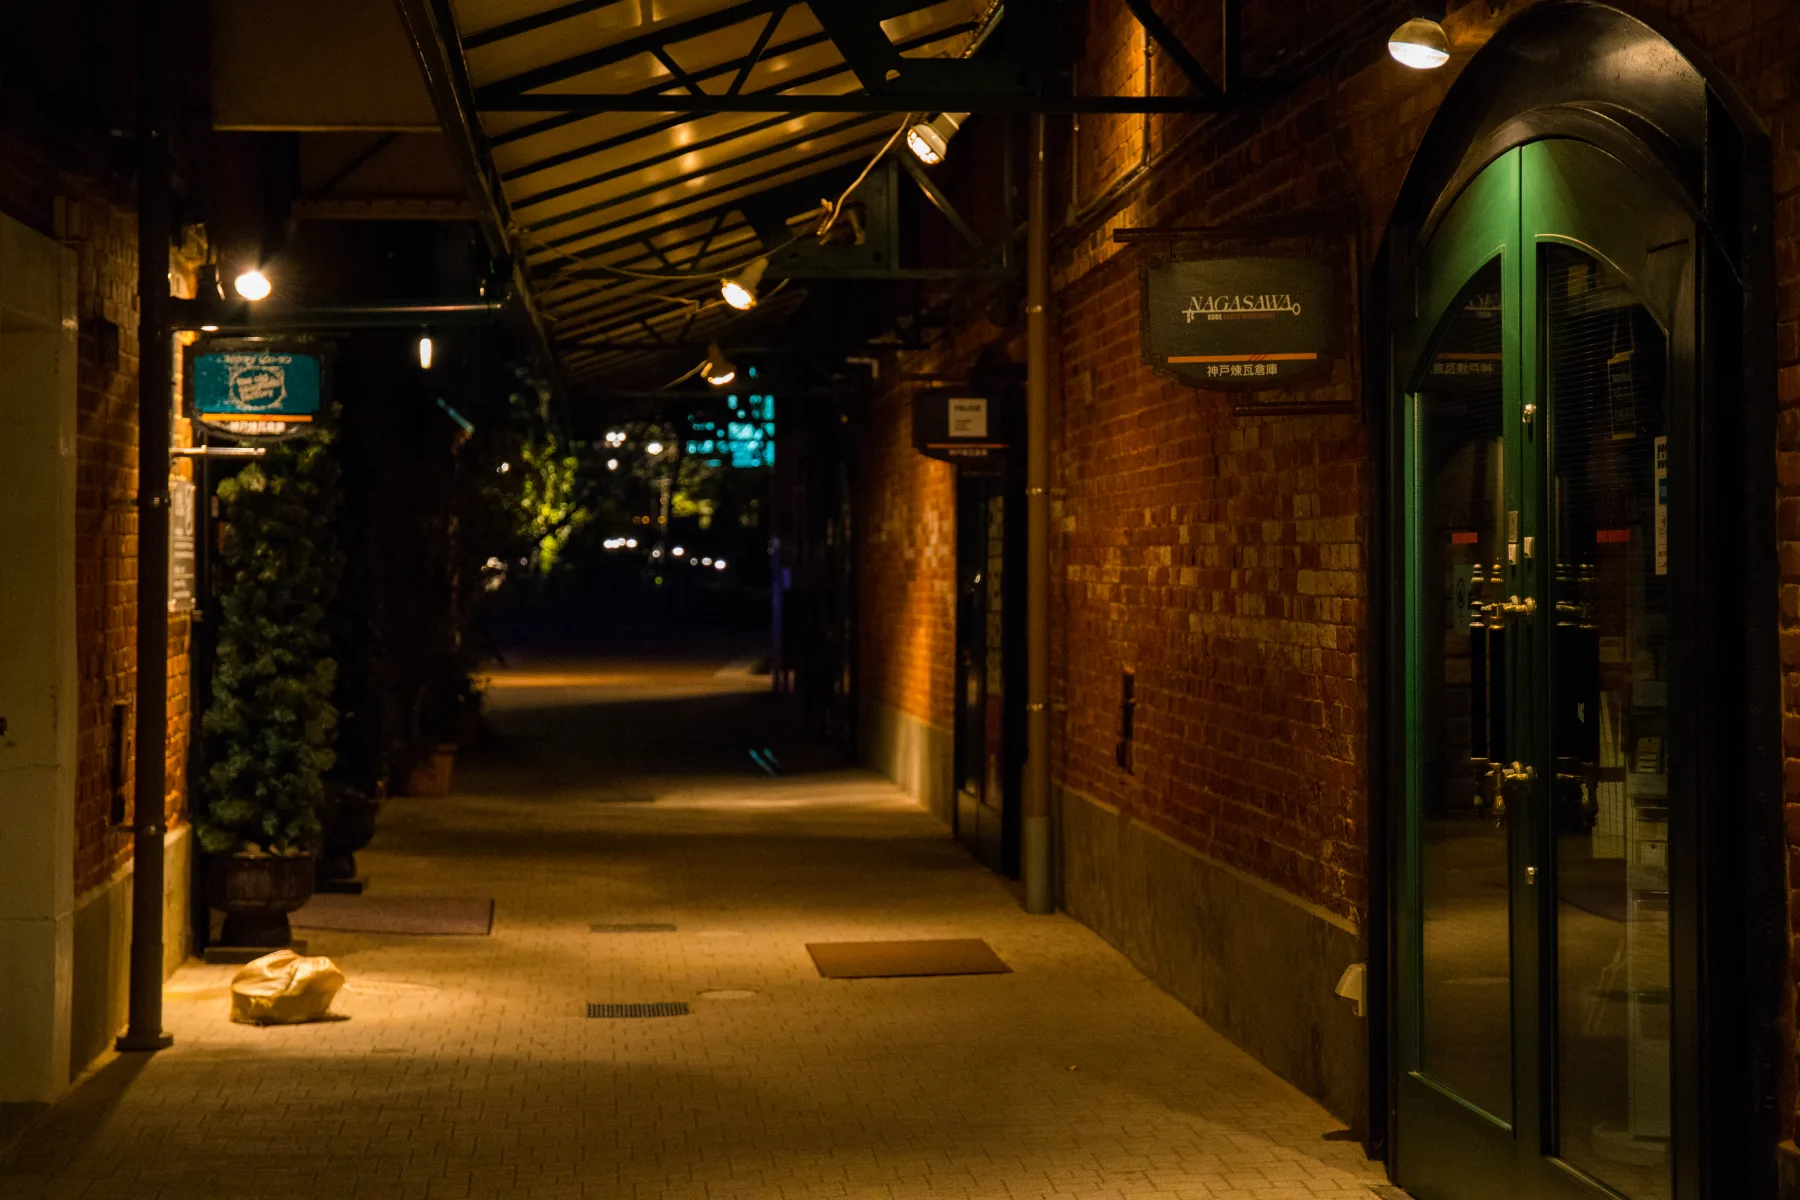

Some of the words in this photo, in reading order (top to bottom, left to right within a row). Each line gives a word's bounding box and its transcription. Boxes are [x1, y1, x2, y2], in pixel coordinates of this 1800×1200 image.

[1188, 294, 1292, 311] NAGASAWA
[1207, 363, 1278, 377] 神戸煉瓦倉庫
